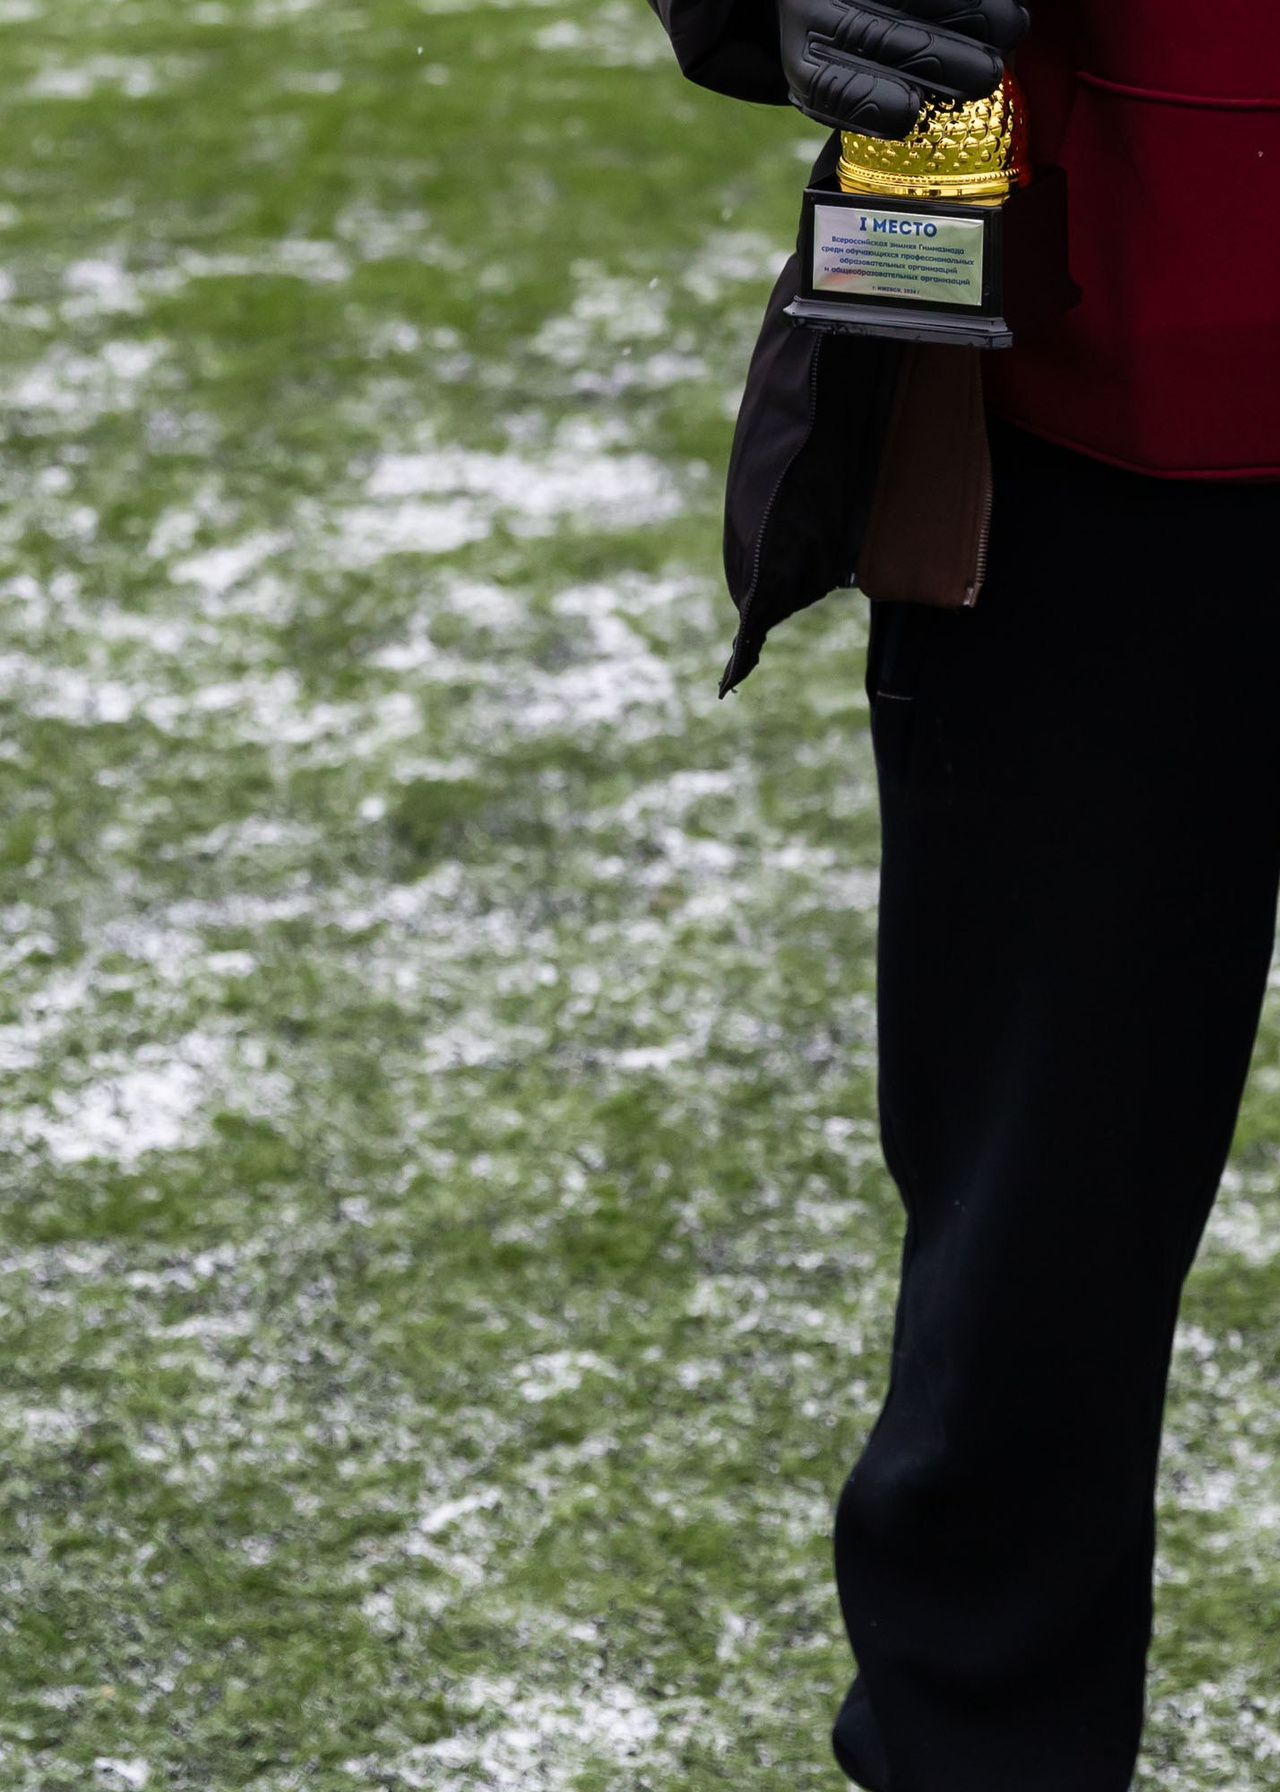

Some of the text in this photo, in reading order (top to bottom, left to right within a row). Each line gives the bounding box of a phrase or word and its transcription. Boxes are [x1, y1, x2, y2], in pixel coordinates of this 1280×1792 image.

[860, 217, 938, 238] I МЕСТО
[832, 236, 965, 255] Всероссийская зимняя Гимназиада
[822, 246, 974, 265] среди обучающихся профессиональных
[840, 258, 957, 274] образовательных организаций
[920, 275, 970, 286] организаций
